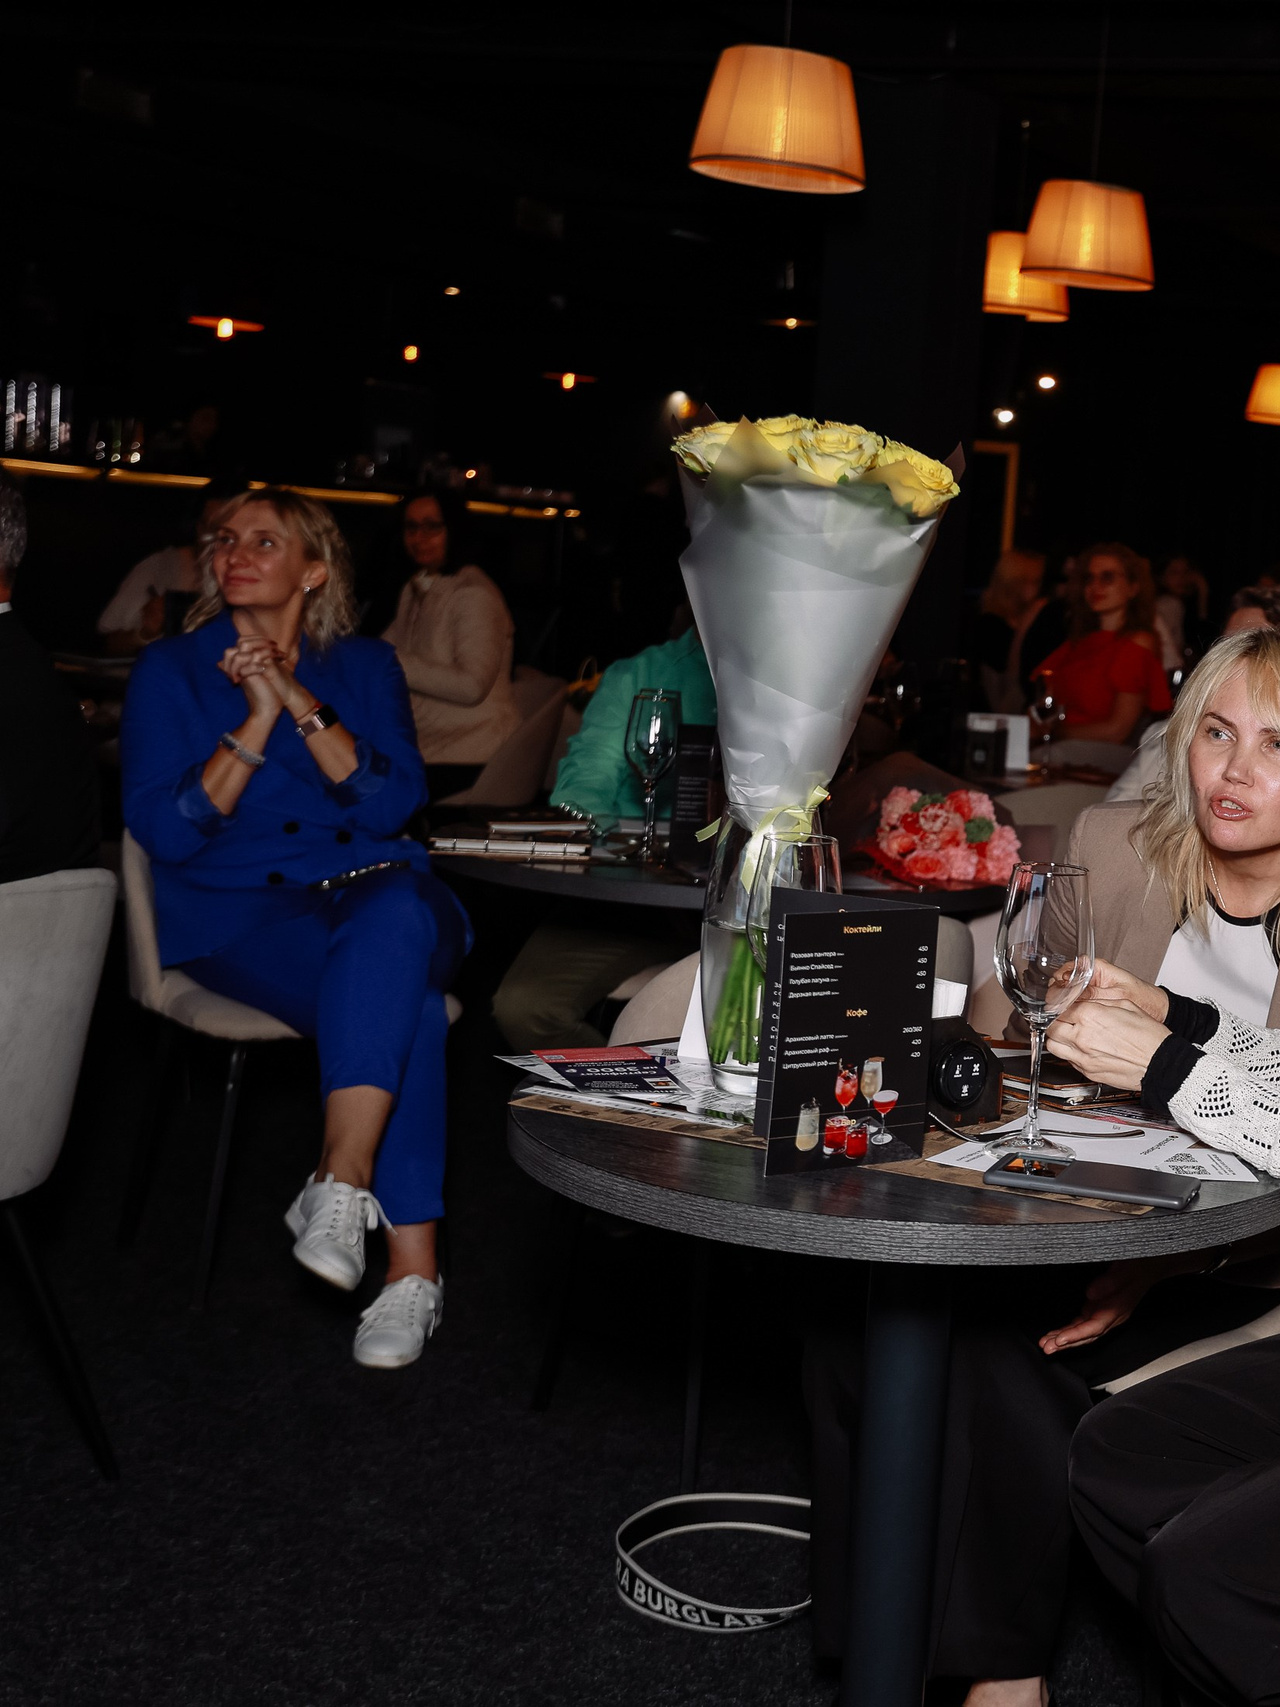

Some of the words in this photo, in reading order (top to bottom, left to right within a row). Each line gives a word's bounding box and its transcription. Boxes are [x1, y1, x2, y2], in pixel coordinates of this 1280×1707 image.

[843, 924, 882, 934] Коктейли
[846, 1008, 868, 1018] Кофе
[785, 1035, 819, 1043] Арахисовый
[784, 1048, 818, 1056] Арахисовый
[782, 1061, 816, 1069] Цитрусовый
[633, 1579, 769, 1628] BURGLAR
